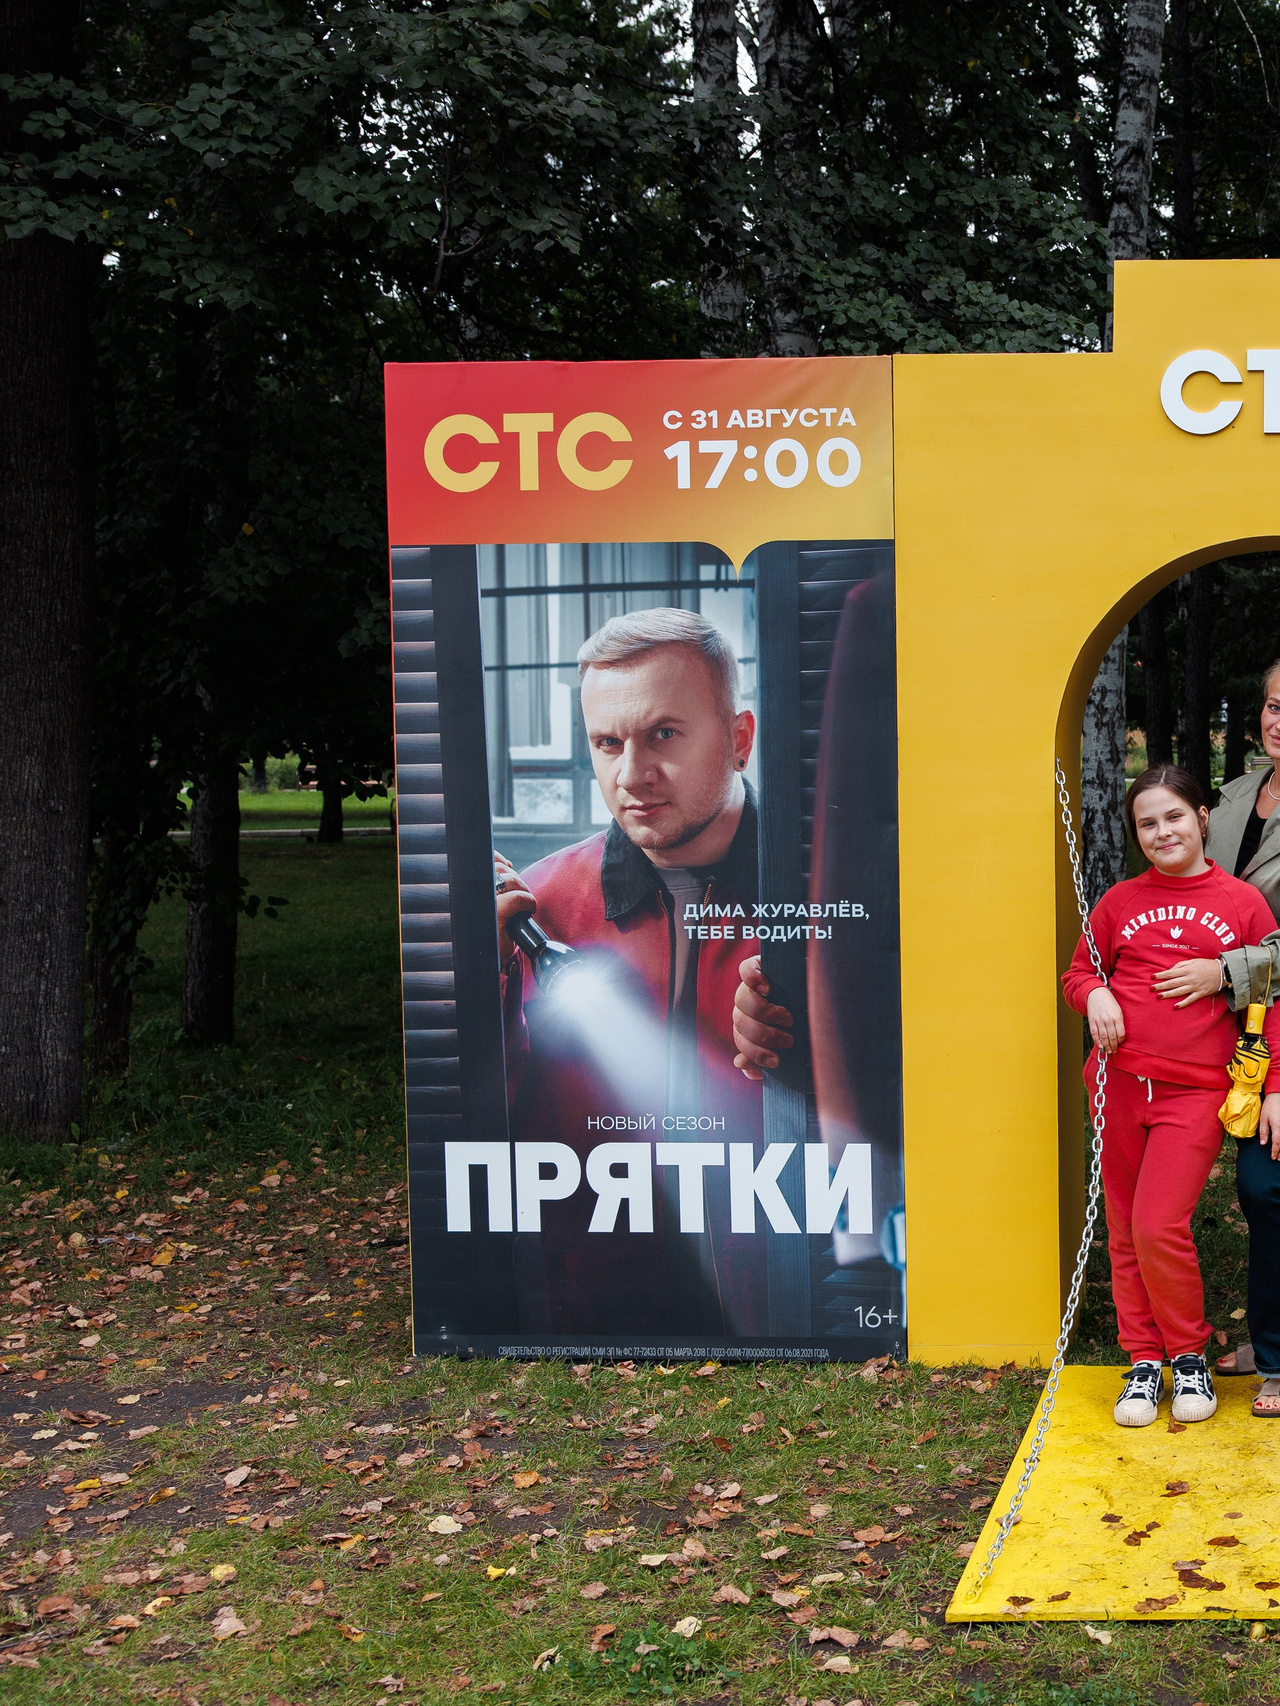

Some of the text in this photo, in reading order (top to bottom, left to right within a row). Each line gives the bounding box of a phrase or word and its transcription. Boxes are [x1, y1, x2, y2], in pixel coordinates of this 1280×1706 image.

[663, 407, 857, 430] С 31 АВГУСТА
[424, 412, 633, 493] СТС
[663, 437, 862, 490] 17:00
[683, 900, 870, 920] ДИМА ЖУРАВЛЁВ,
[684, 925, 832, 942] ТЕБЕ ВОДИТЬ!
[1120, 905, 1236, 946] MINIDINO CLUB
[587, 1113, 725, 1131] НОВЫЙ СЕЗОН
[444, 1141, 873, 1234] ПРЯТКИ
[854, 1305, 898, 1328] 16+
[498, 1346, 545, 1356] СВИДЕТЕЛЬСТВО
[591, 1347, 606, 1356] СМИ
[674, 1347, 693, 1357] МАРТА
[813, 1349, 830, 1359] ГОДА
